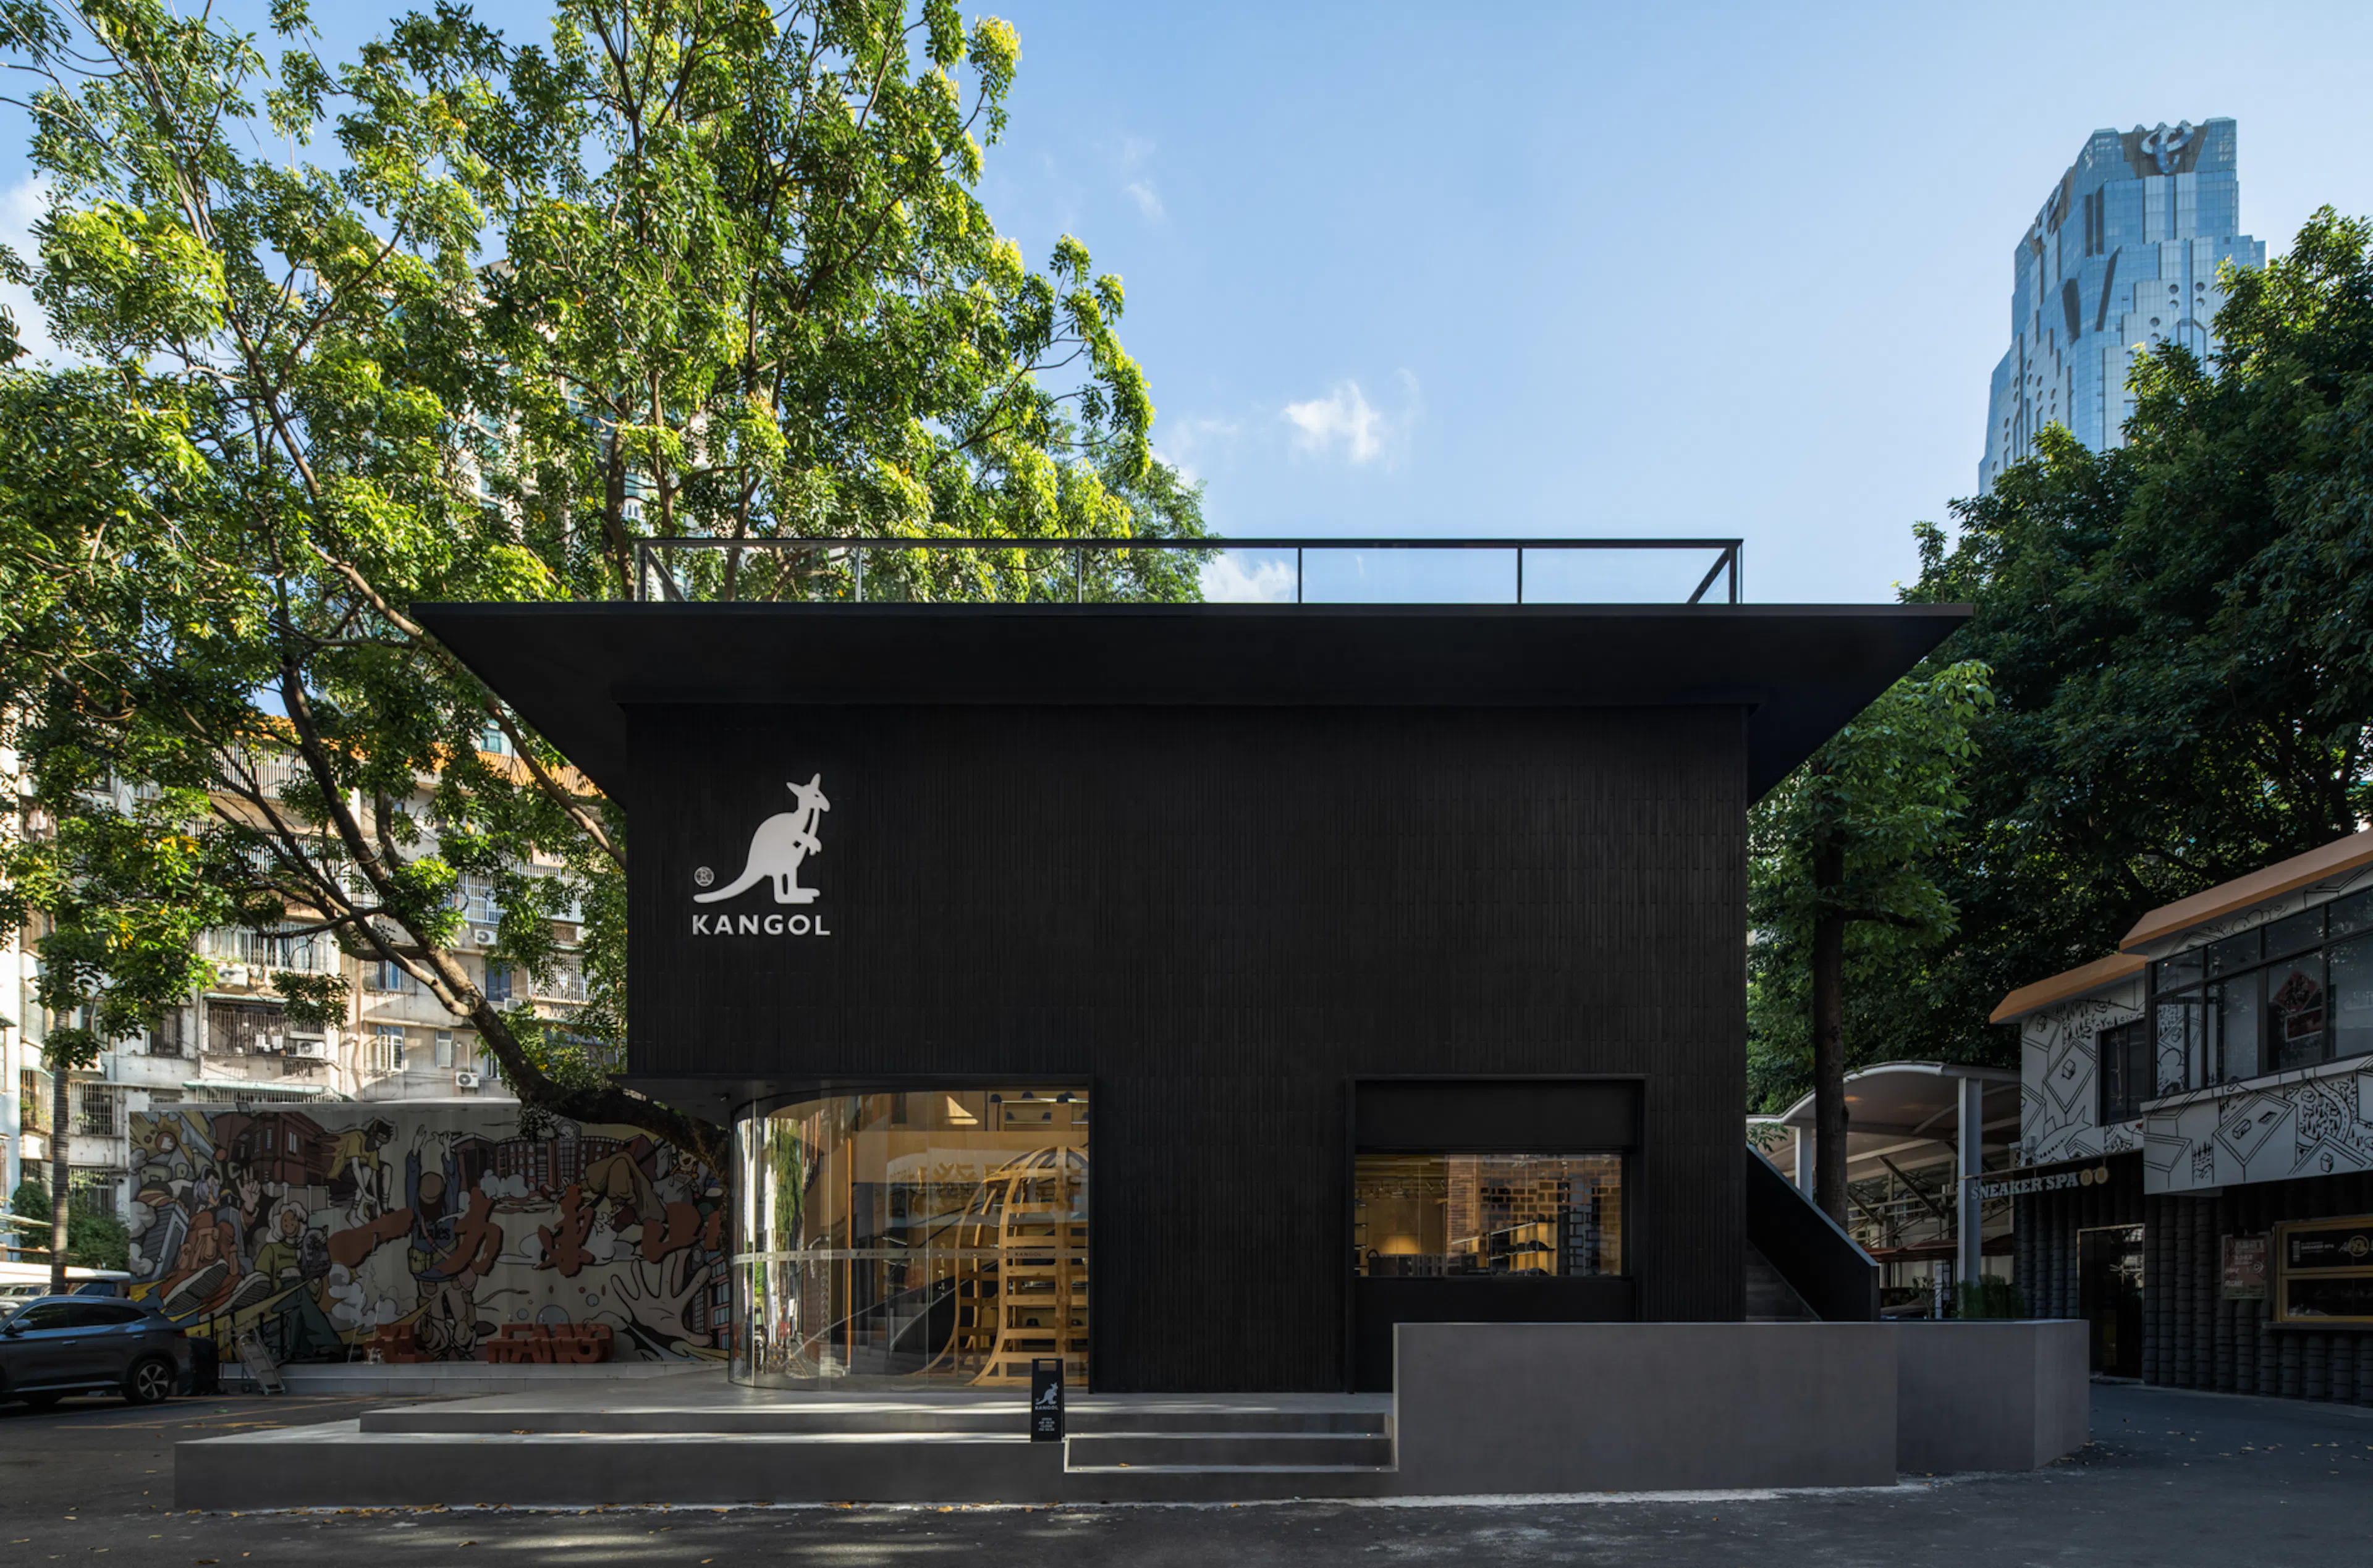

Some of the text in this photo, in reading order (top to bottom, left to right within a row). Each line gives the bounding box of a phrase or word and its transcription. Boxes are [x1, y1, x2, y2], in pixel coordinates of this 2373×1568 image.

[692, 914, 831, 935] KANGOL
[1971, 1171, 2079, 1200] SNEAKER SPA
